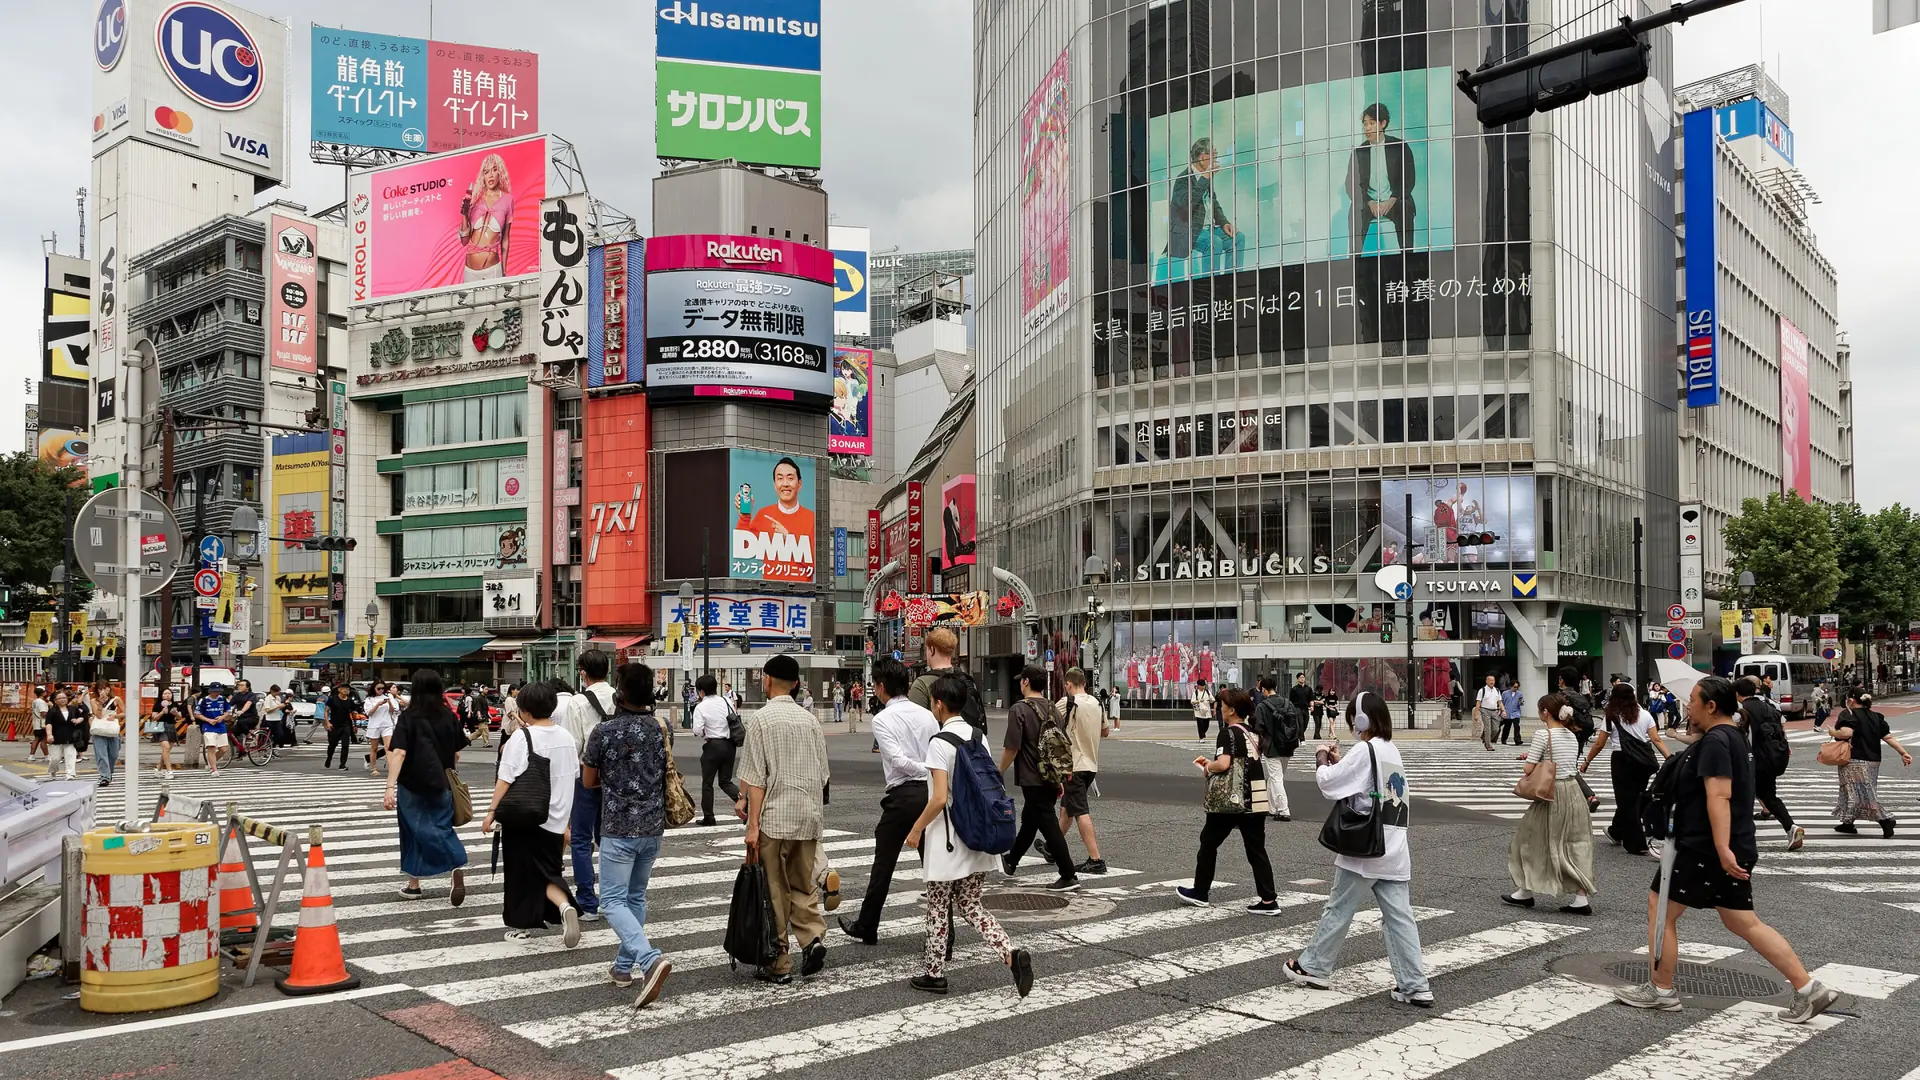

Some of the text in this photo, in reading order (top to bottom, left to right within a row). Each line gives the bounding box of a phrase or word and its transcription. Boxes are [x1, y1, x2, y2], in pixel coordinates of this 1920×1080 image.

[660, 1, 818, 37] Hisamitsu
[171, 19, 252, 86] UC
[337, 55, 404, 88] 龍角散
[452, 68, 517, 100] 龍角散
[327, 84, 417, 117] ダイレクト
[112, 105, 126, 121] VISA
[338, 116, 373, 127] スティック
[443, 97, 529, 129] ダイレクト
[667, 90, 811, 137] サロンパス
[156, 127, 192, 142] mastercard
[225, 131, 269, 159] VISA
[404, 134, 421, 143] 生薬
[453, 128, 486, 138] スティック
[1645, 163, 1671, 195] TSUTAYA
[383, 185, 409, 200] Coke
[355, 220, 366, 301] KAROL G
[707, 241, 782, 264] Rakuten
[870, 257, 904, 269] HULIC
[543, 200, 583, 355] もんじゃ
[696, 279, 792, 295] Rakuten 最強プラン
[286, 287, 304, 297] 10:00
[282, 311, 307, 328] B1F
[605, 247, 622, 376] 三千里薬品
[683, 308, 805, 336] データ無制限
[282, 327, 307, 344] B2F
[411, 332, 463, 362] 西村
[682, 340, 740, 359] 2,880
[1688, 309, 1713, 392] SEIBU
[100, 390, 113, 407] 7F
[723, 387, 766, 396] Rakuten Vision
[1156, 413, 1281, 437] SHARE LOUNGE
[275, 462, 310, 470] Matsumoto
[588, 482, 643, 564] クスリ
[909, 490, 920, 547] カラオケ
[733, 528, 813, 564] DMM
[733, 561, 814, 577] オンラインクリニック
[1137, 555, 1328, 580] STARBUCKS
[485, 582, 503, 591] うなぎ
[1426, 580, 1502, 592] TSUTAYA
[493, 593, 521, 611] 松川
[670, 601, 807, 629] 大盛堂書店
